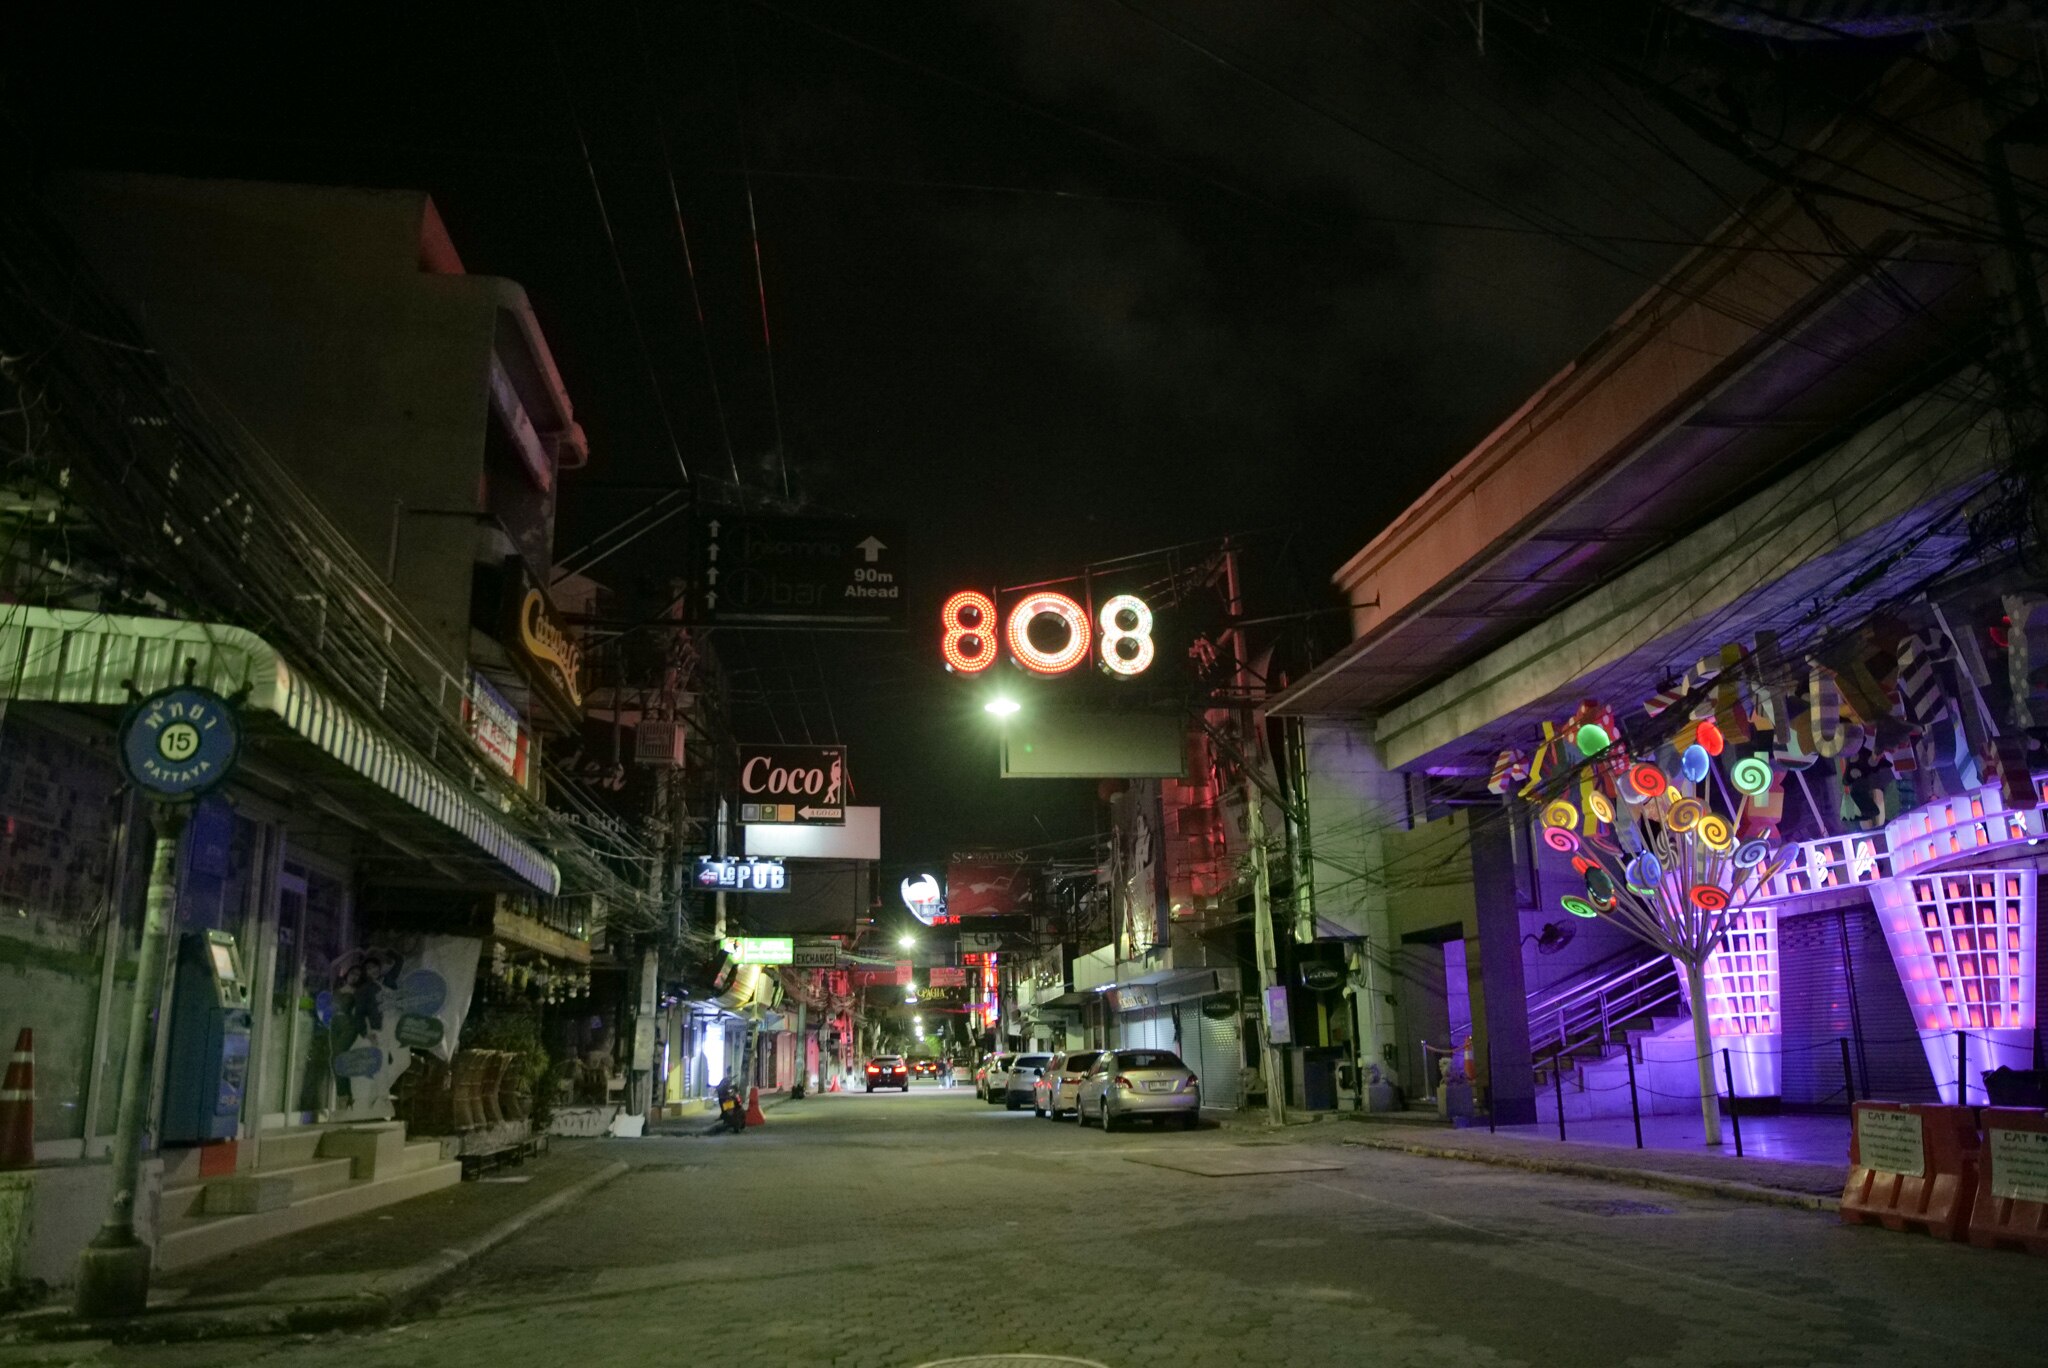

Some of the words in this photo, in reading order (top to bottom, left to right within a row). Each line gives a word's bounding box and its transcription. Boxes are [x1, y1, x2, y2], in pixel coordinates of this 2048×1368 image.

[853, 567, 894, 584] 90m
[844, 584, 899, 599] Ahead
[167, 731, 192, 752] 15
[143, 758, 212, 783] PATTAYA
[741, 755, 825, 796] Coco
[720, 865, 736, 881] Le
[736, 863, 785, 890] PUB
[796, 953, 835, 963] EXCHANGE
[1868, 1111, 1886, 1121] CAT
[2004, 1132, 2028, 1143] CAT
